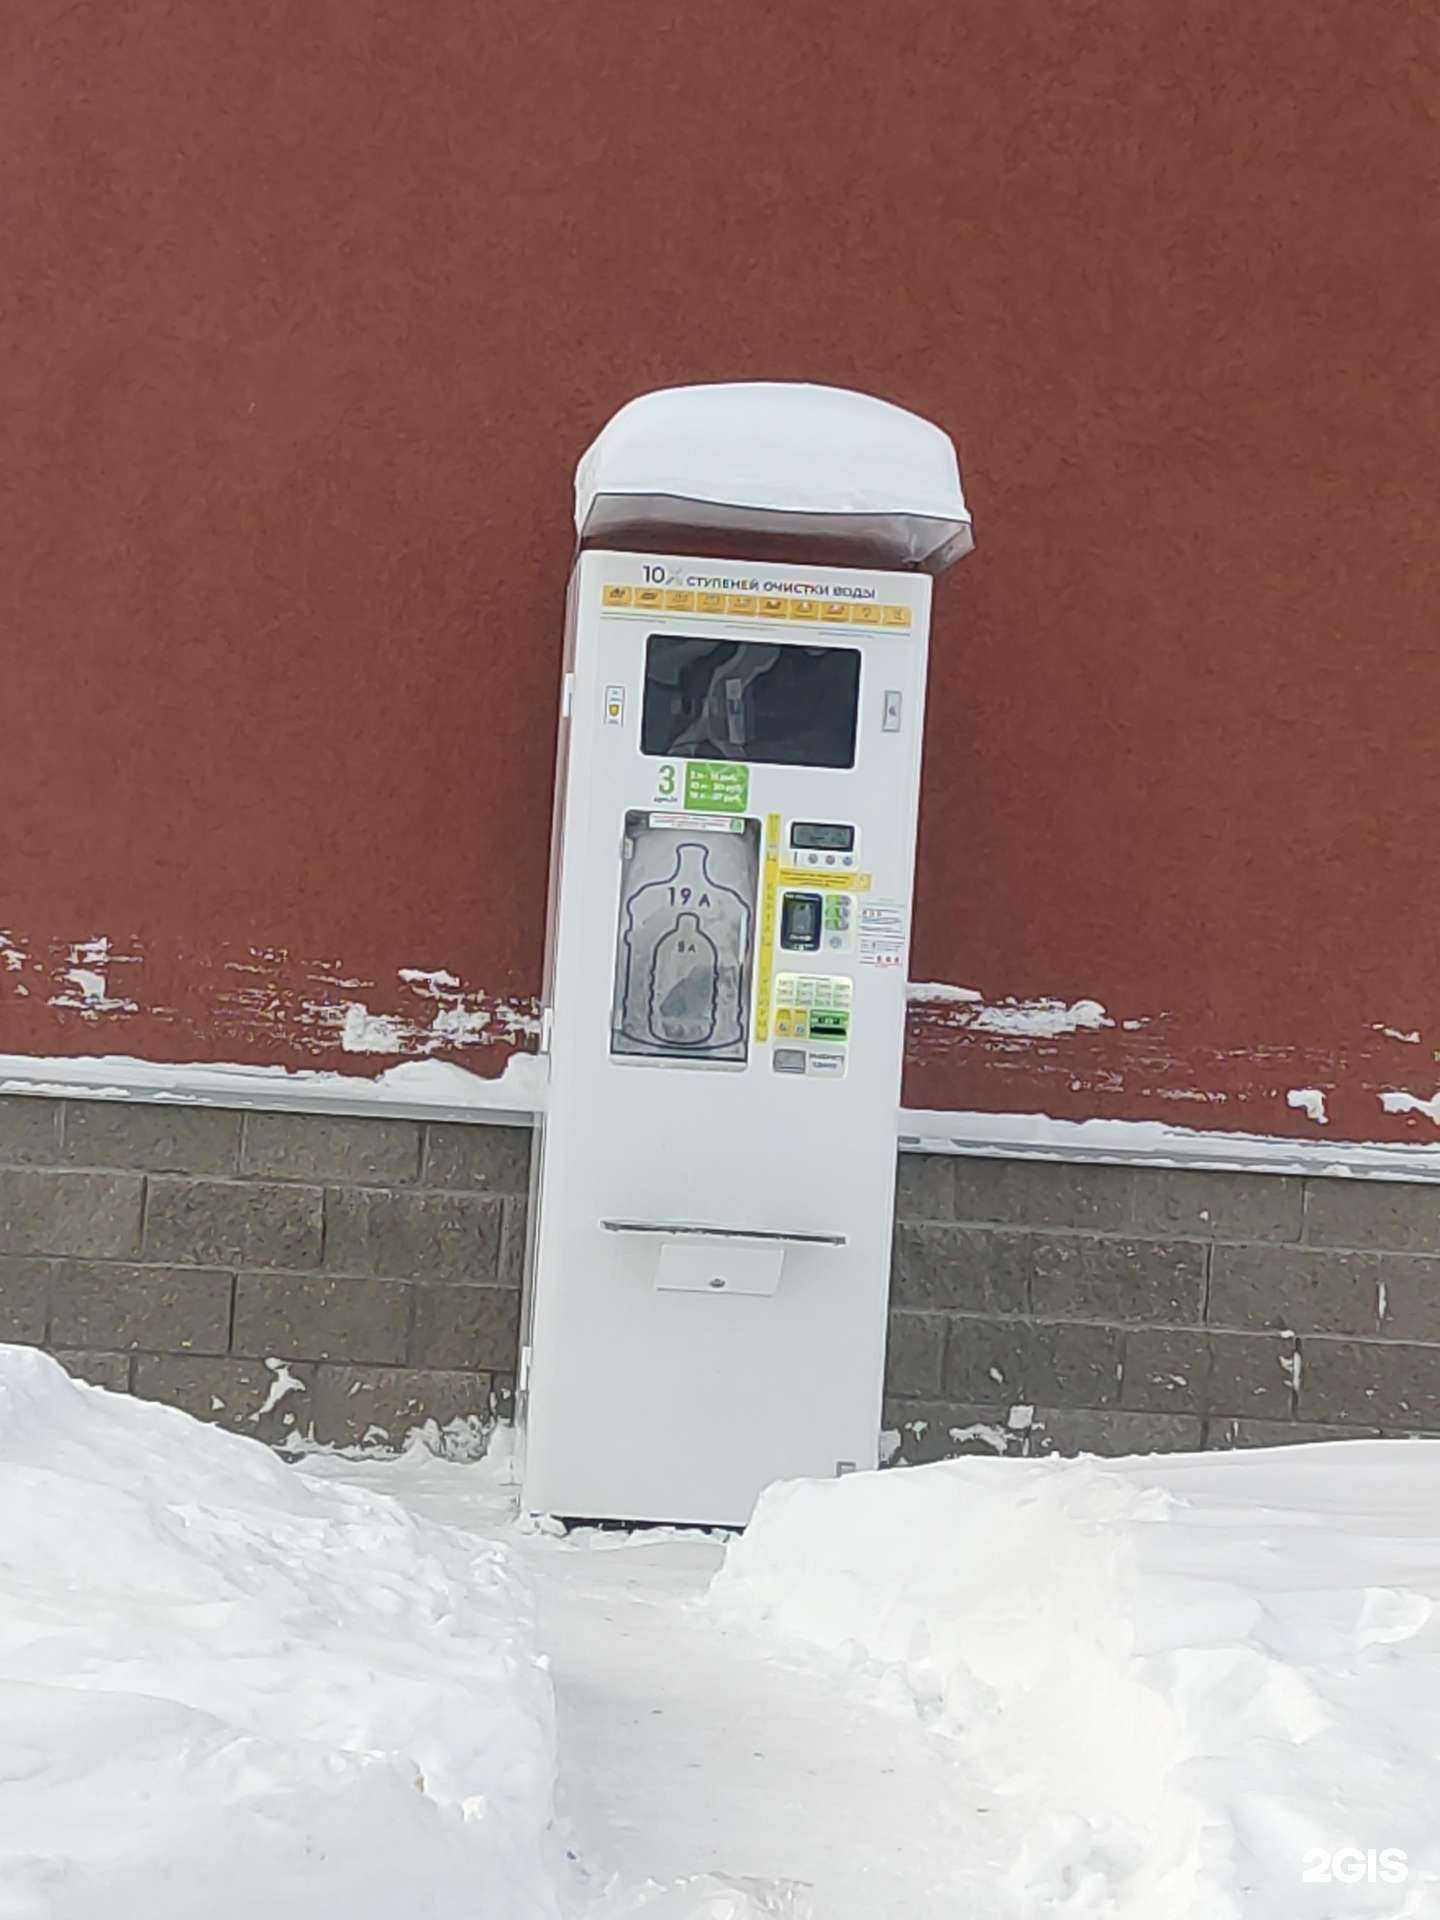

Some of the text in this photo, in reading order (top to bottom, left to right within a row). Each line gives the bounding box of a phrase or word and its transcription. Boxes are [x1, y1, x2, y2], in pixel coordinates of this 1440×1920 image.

[642, 565, 876, 599] 10 СТУПЕНЕЙ ОЧИСТКИ ВОДЫ
[658, 764, 675, 795] 3
[668, 887, 692, 906] 19
